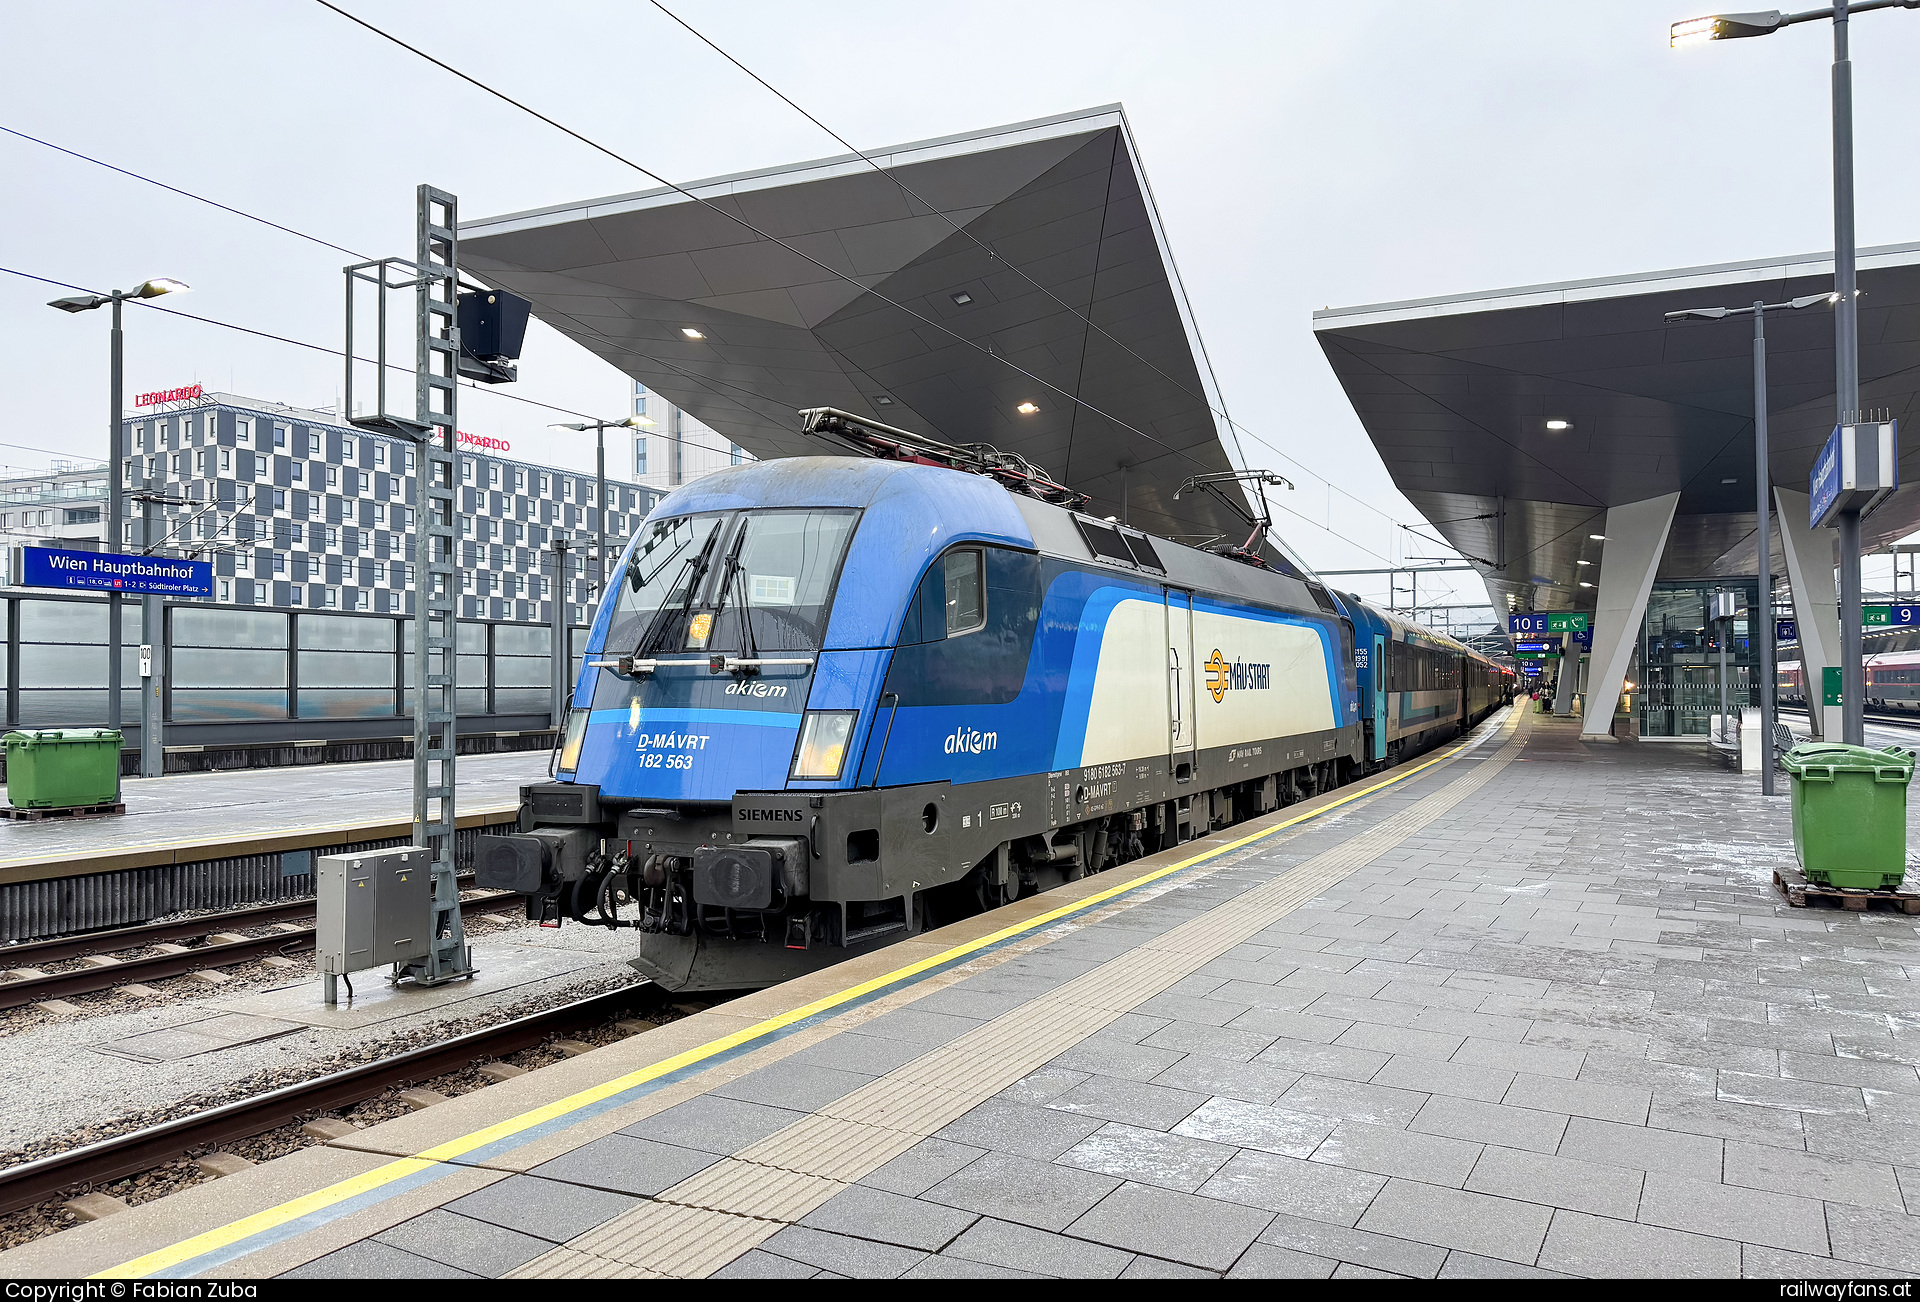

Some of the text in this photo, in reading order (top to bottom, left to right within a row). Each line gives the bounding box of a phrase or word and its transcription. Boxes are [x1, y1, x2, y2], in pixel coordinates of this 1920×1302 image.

[135, 384, 202, 408] LEONARDO
[438, 426, 511, 452] LONARDO
[49, 555, 194, 579] Wien Hauptbahnhof
[124, 580, 137, 588] 1-2
[148, 582, 181, 592] Südtiroler
[182, 584, 199, 593] Platz
[1513, 617, 1543, 630] 10 E
[1900, 608, 1912, 622] 9
[140, 647, 151, 660] 100
[143, 661, 147, 674] 1
[1229, 655, 1271, 690] MÁV-START
[724, 680, 788, 698] akiem
[636, 731, 710, 752] D-MÁVRT
[944, 726, 998, 755] akiem
[638, 753, 693, 770] 182 563
[1083, 781, 1112, 803] D-MÁVRT
[738, 808, 803, 822] SIEMENS
[977, 810, 982, 828] 1
